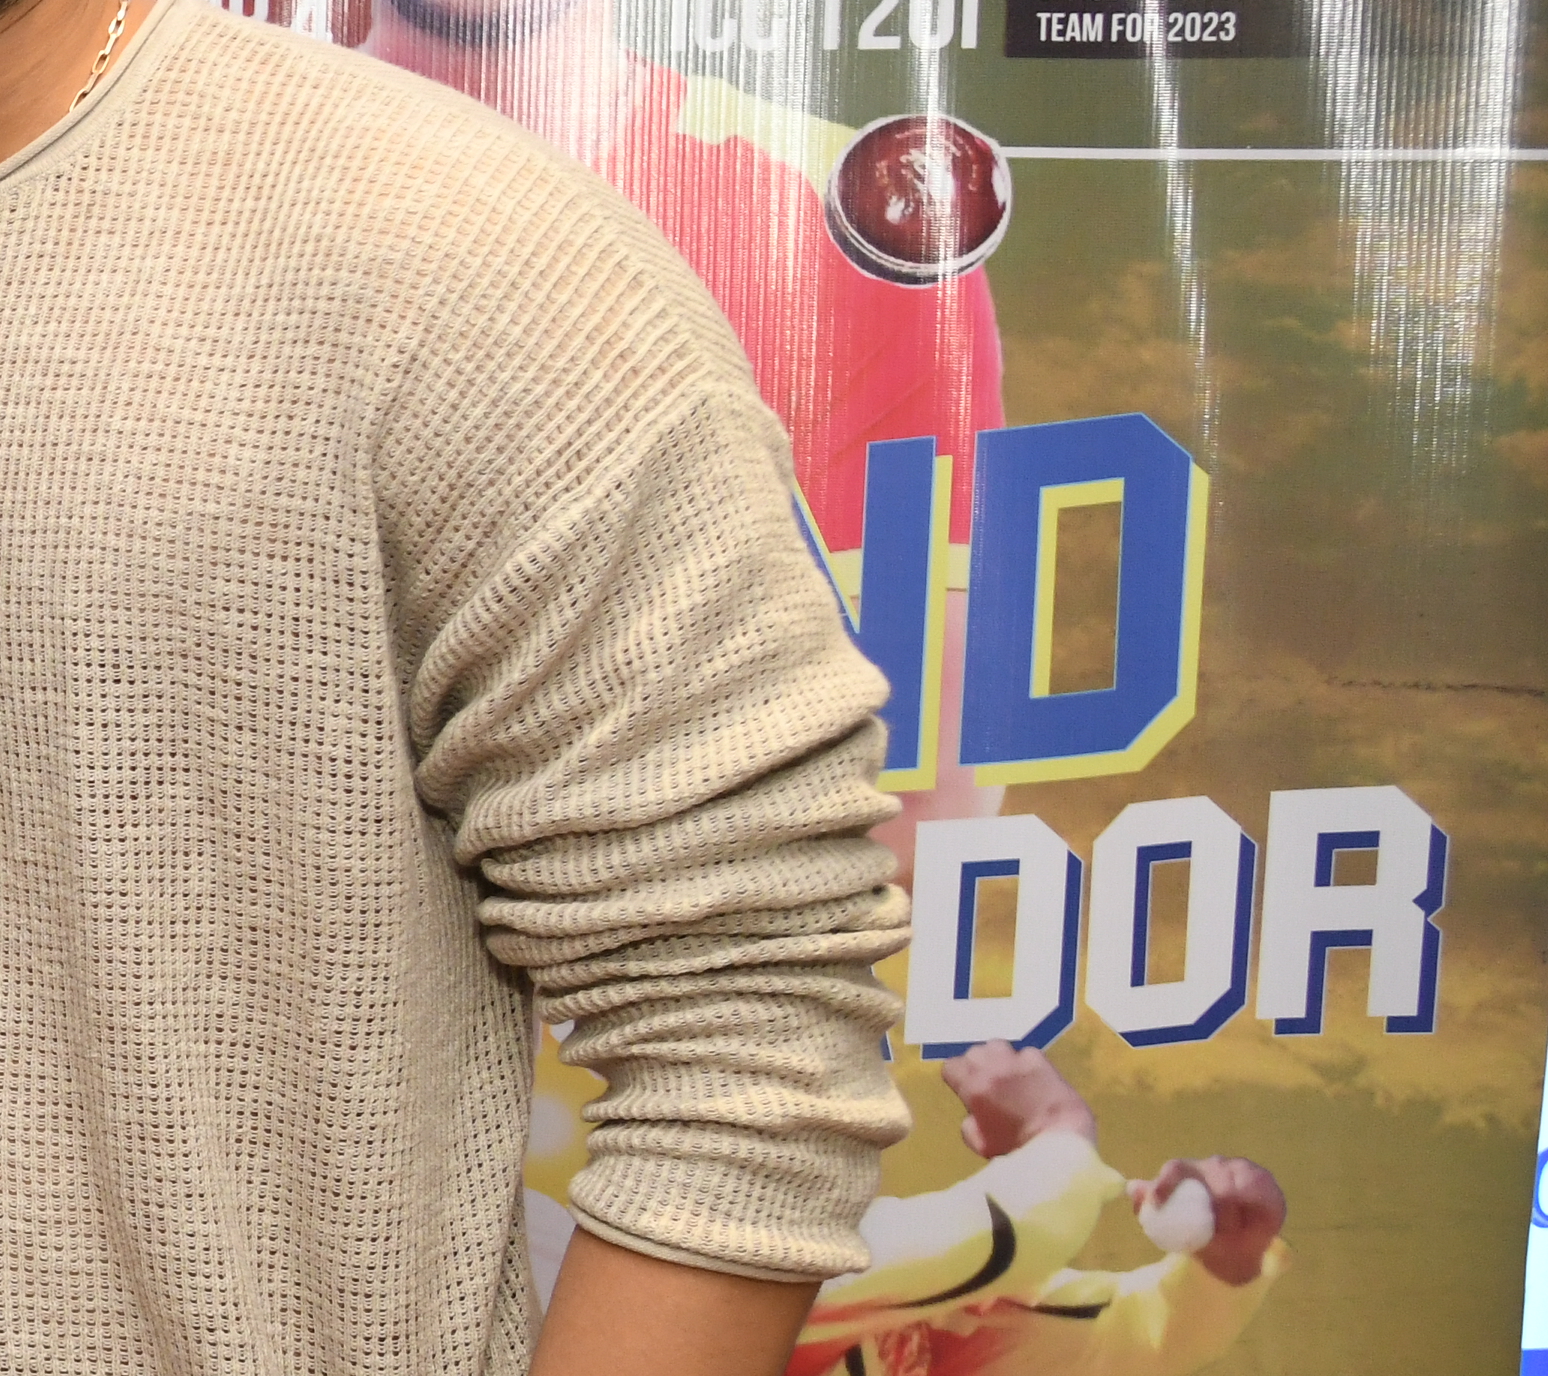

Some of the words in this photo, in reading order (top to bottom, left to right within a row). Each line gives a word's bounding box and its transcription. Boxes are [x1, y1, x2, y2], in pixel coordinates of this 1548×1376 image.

[1036, 12, 1104, 42] TEAM
[1111, 12, 1160, 42] FOR
[1167, 11, 1236, 42] 2023
[879, 786, 1449, 1060] DOR
